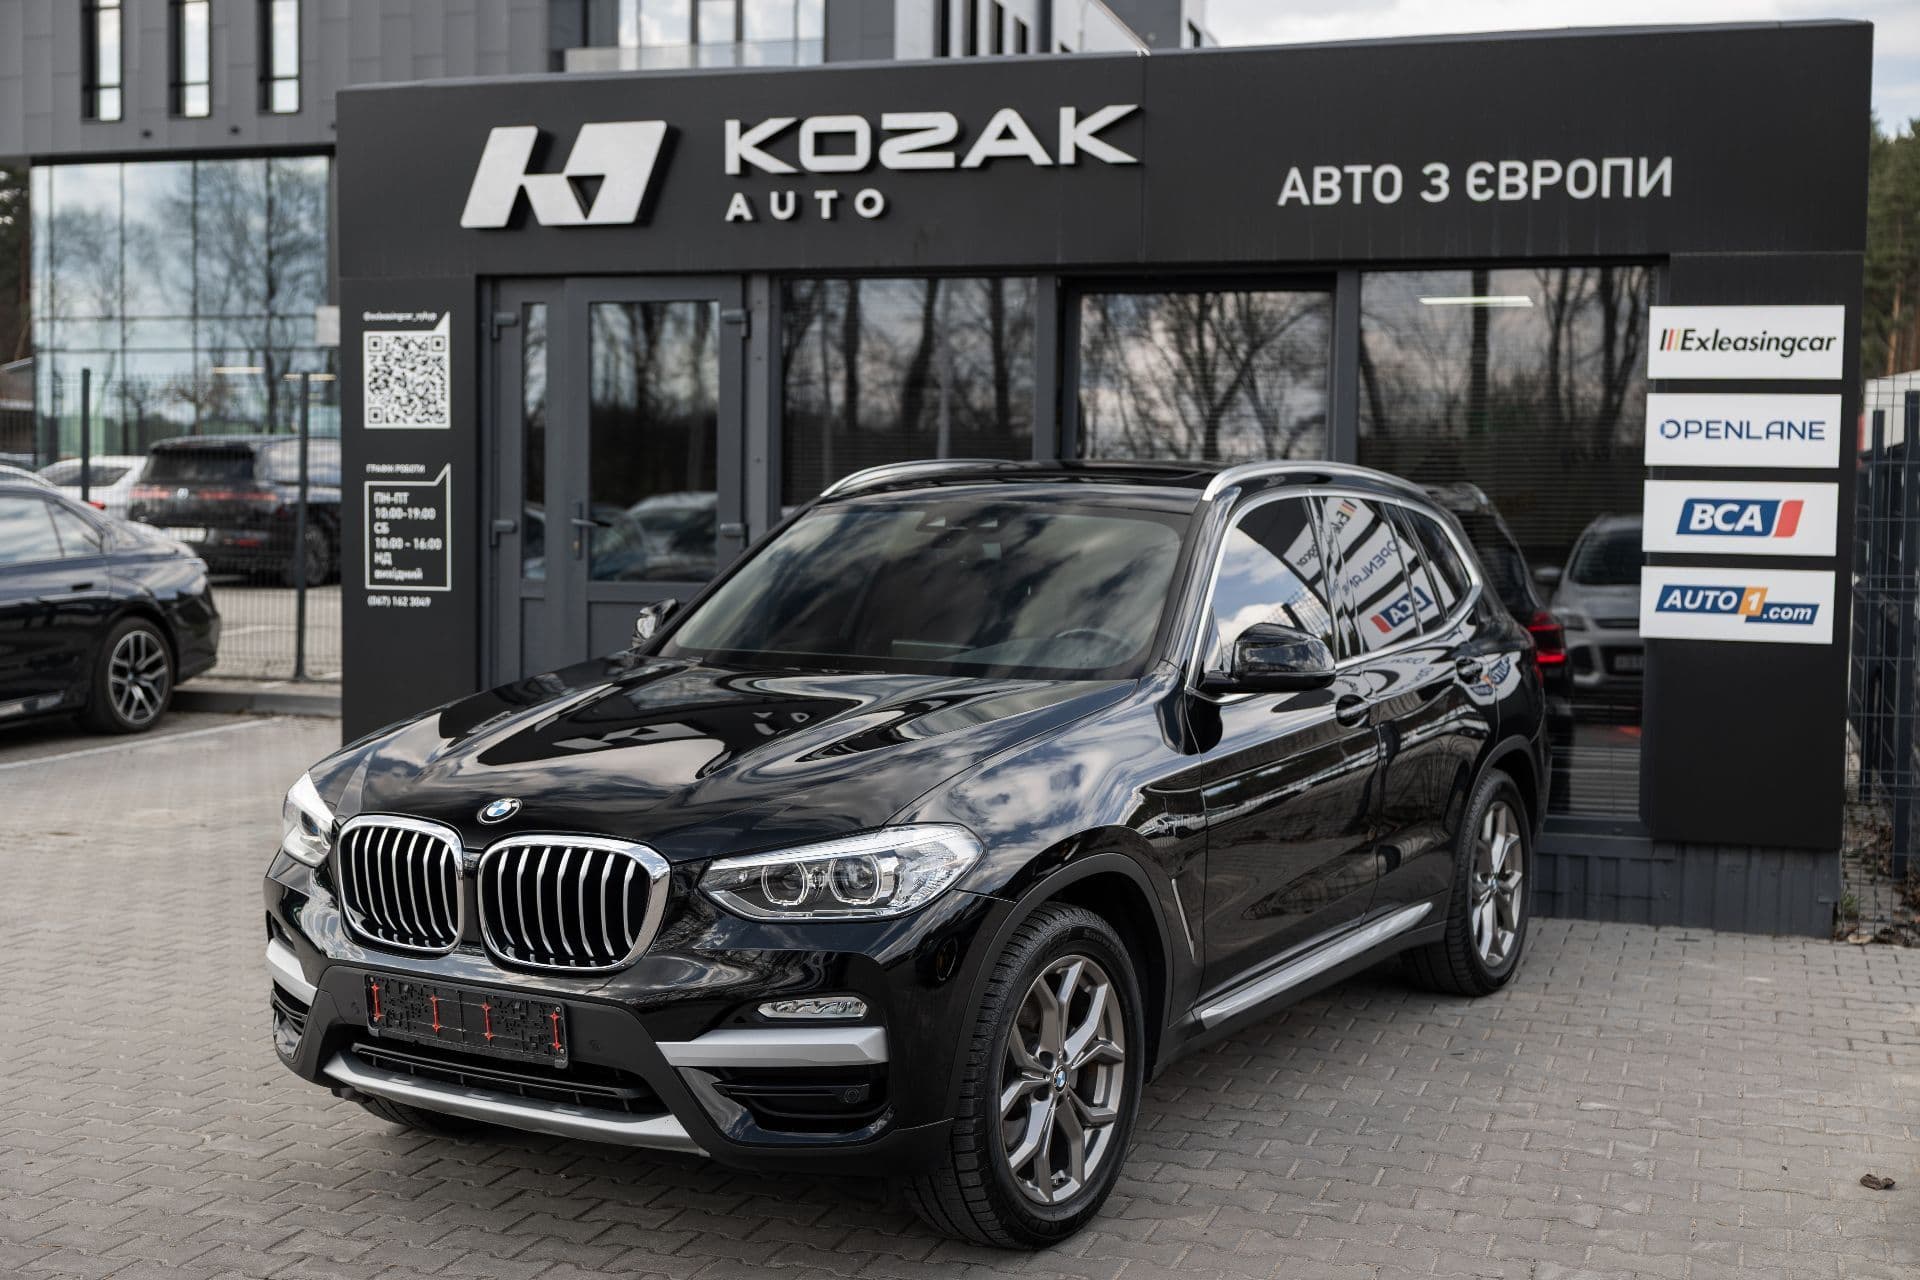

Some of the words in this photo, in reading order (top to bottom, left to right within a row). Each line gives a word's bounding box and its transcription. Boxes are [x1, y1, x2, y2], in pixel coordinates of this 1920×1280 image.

[725, 104, 1138, 175] KOZAK
[1277, 164, 1403, 206] АВТО
[1420, 162, 1450, 203] З
[1466, 157, 1673, 201] ЄВРОПИ
[725, 187, 885, 221] AUTO
[1680, 328, 1837, 358] Exleasingcar
[1660, 419, 1826, 441] OPENLANE
[1689, 502, 1764, 533] BCA
